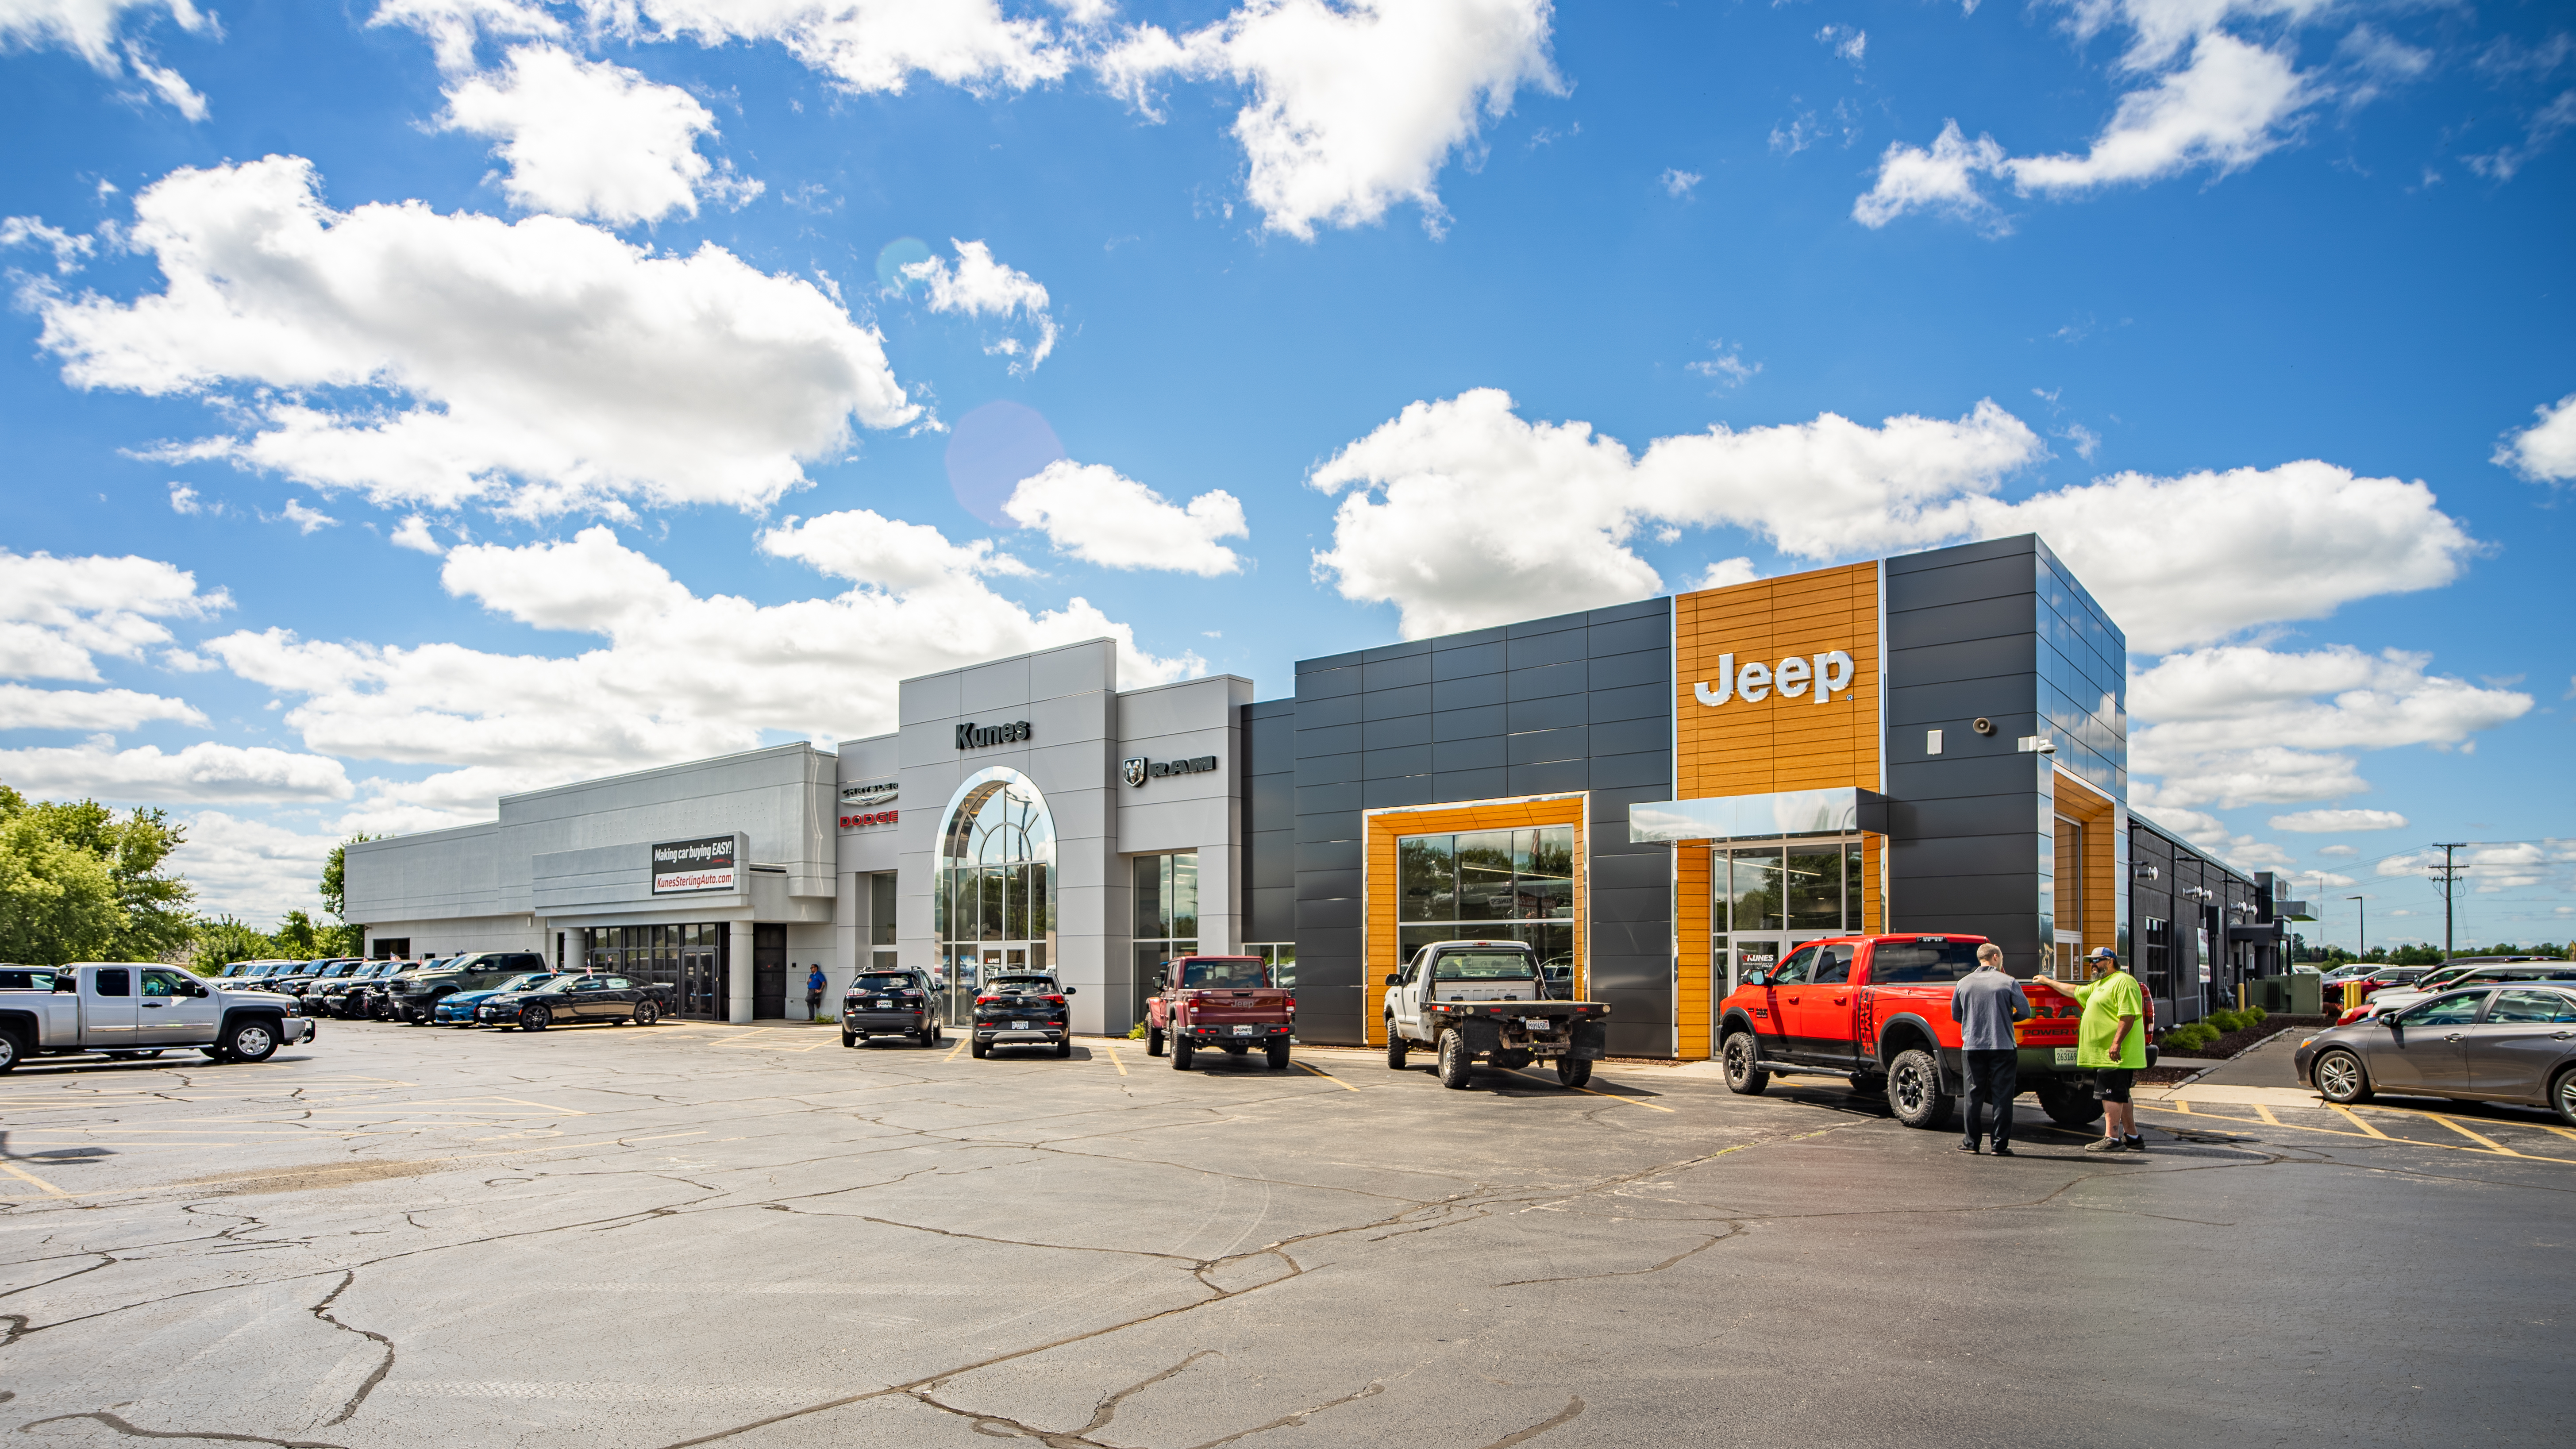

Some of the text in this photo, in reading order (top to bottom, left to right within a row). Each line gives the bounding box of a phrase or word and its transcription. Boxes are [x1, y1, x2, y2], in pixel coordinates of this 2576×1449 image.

[1694, 650, 1854, 707] Jeep
[955, 720, 1030, 749] Kunes
[1149, 755, 1216, 777] RAM
[842, 782, 898, 795] CHRYSLER
[839, 810, 898, 828] DODGE
[655, 841, 732, 863] Making car buying EASY!
[657, 874, 732, 888] KunesSterlingAuto.com
[1231, 1000, 1254, 1009] Jeep
[2029, 1006, 2082, 1018] RA
